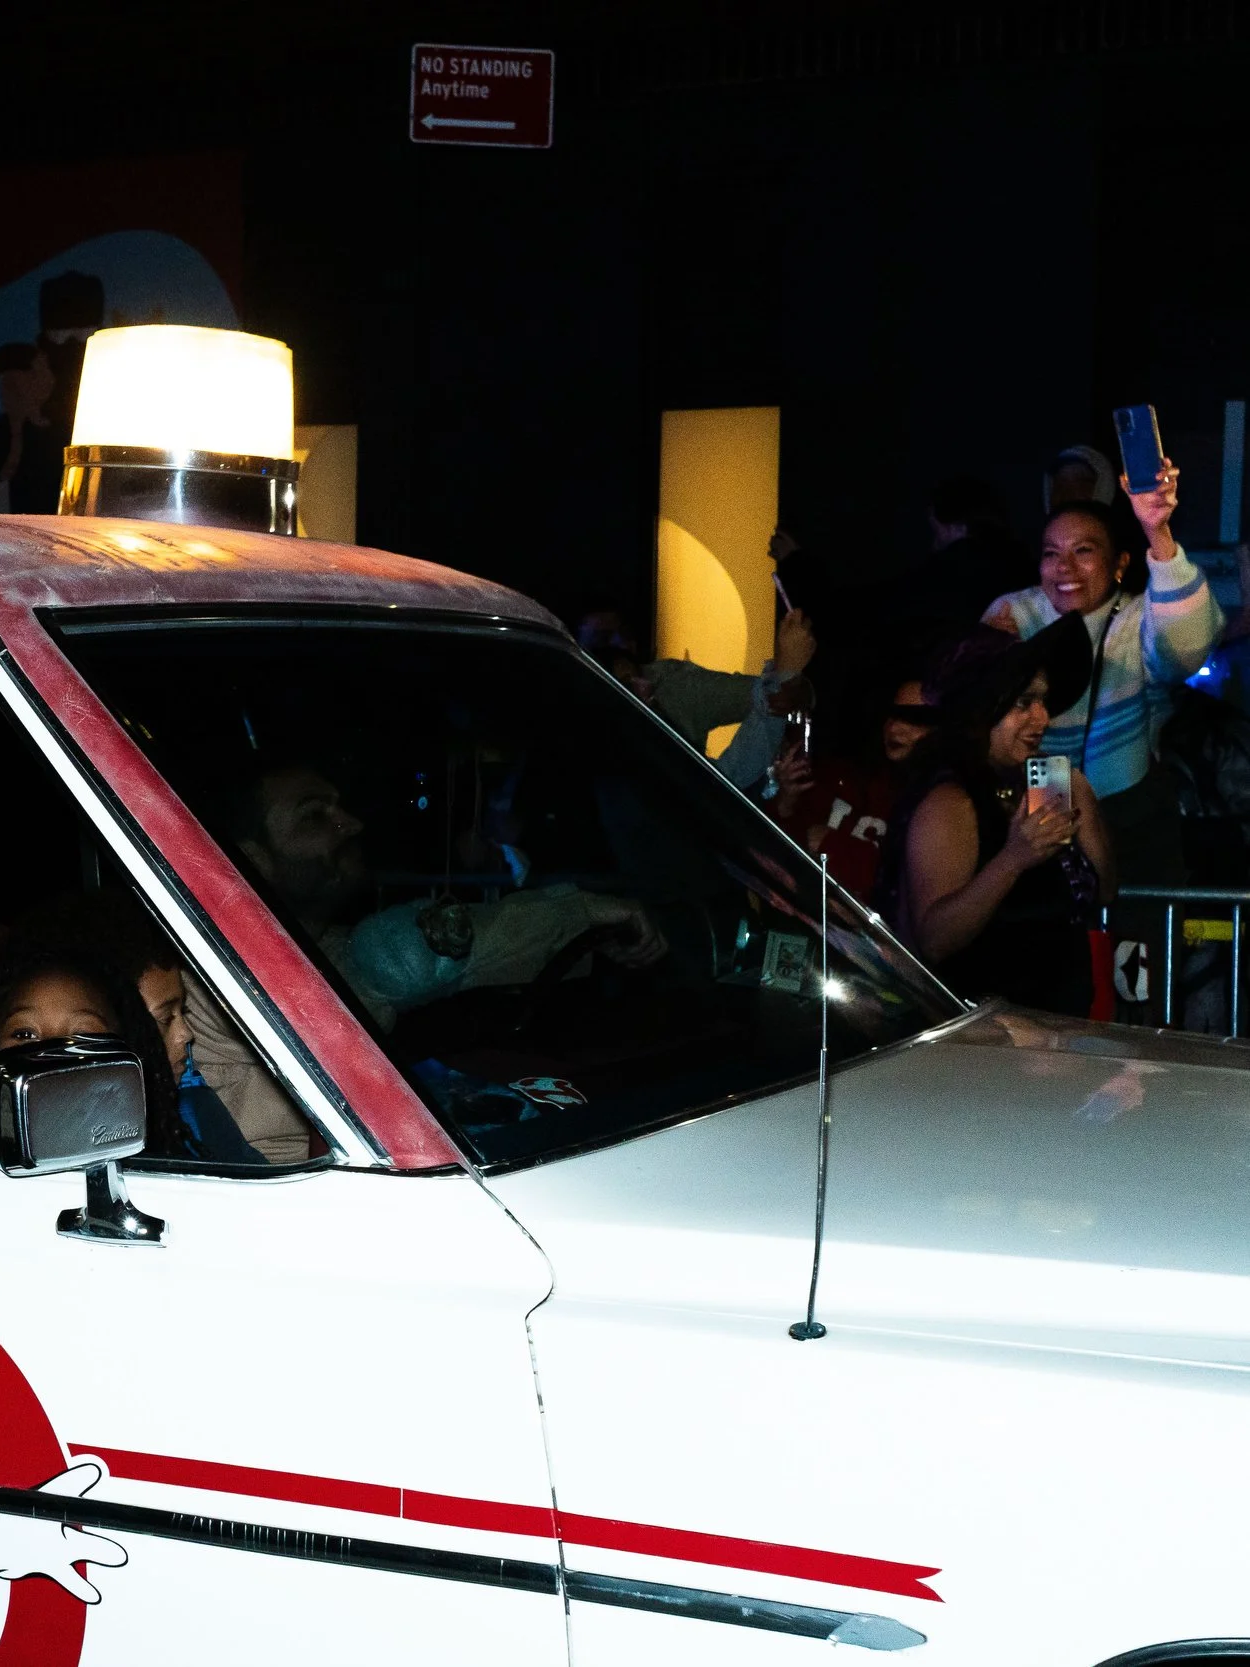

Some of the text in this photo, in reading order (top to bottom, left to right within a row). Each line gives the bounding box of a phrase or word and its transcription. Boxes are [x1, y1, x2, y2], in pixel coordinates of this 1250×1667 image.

[421, 57, 533, 78] NO STANDING
[421, 79, 490, 99] Anytime
